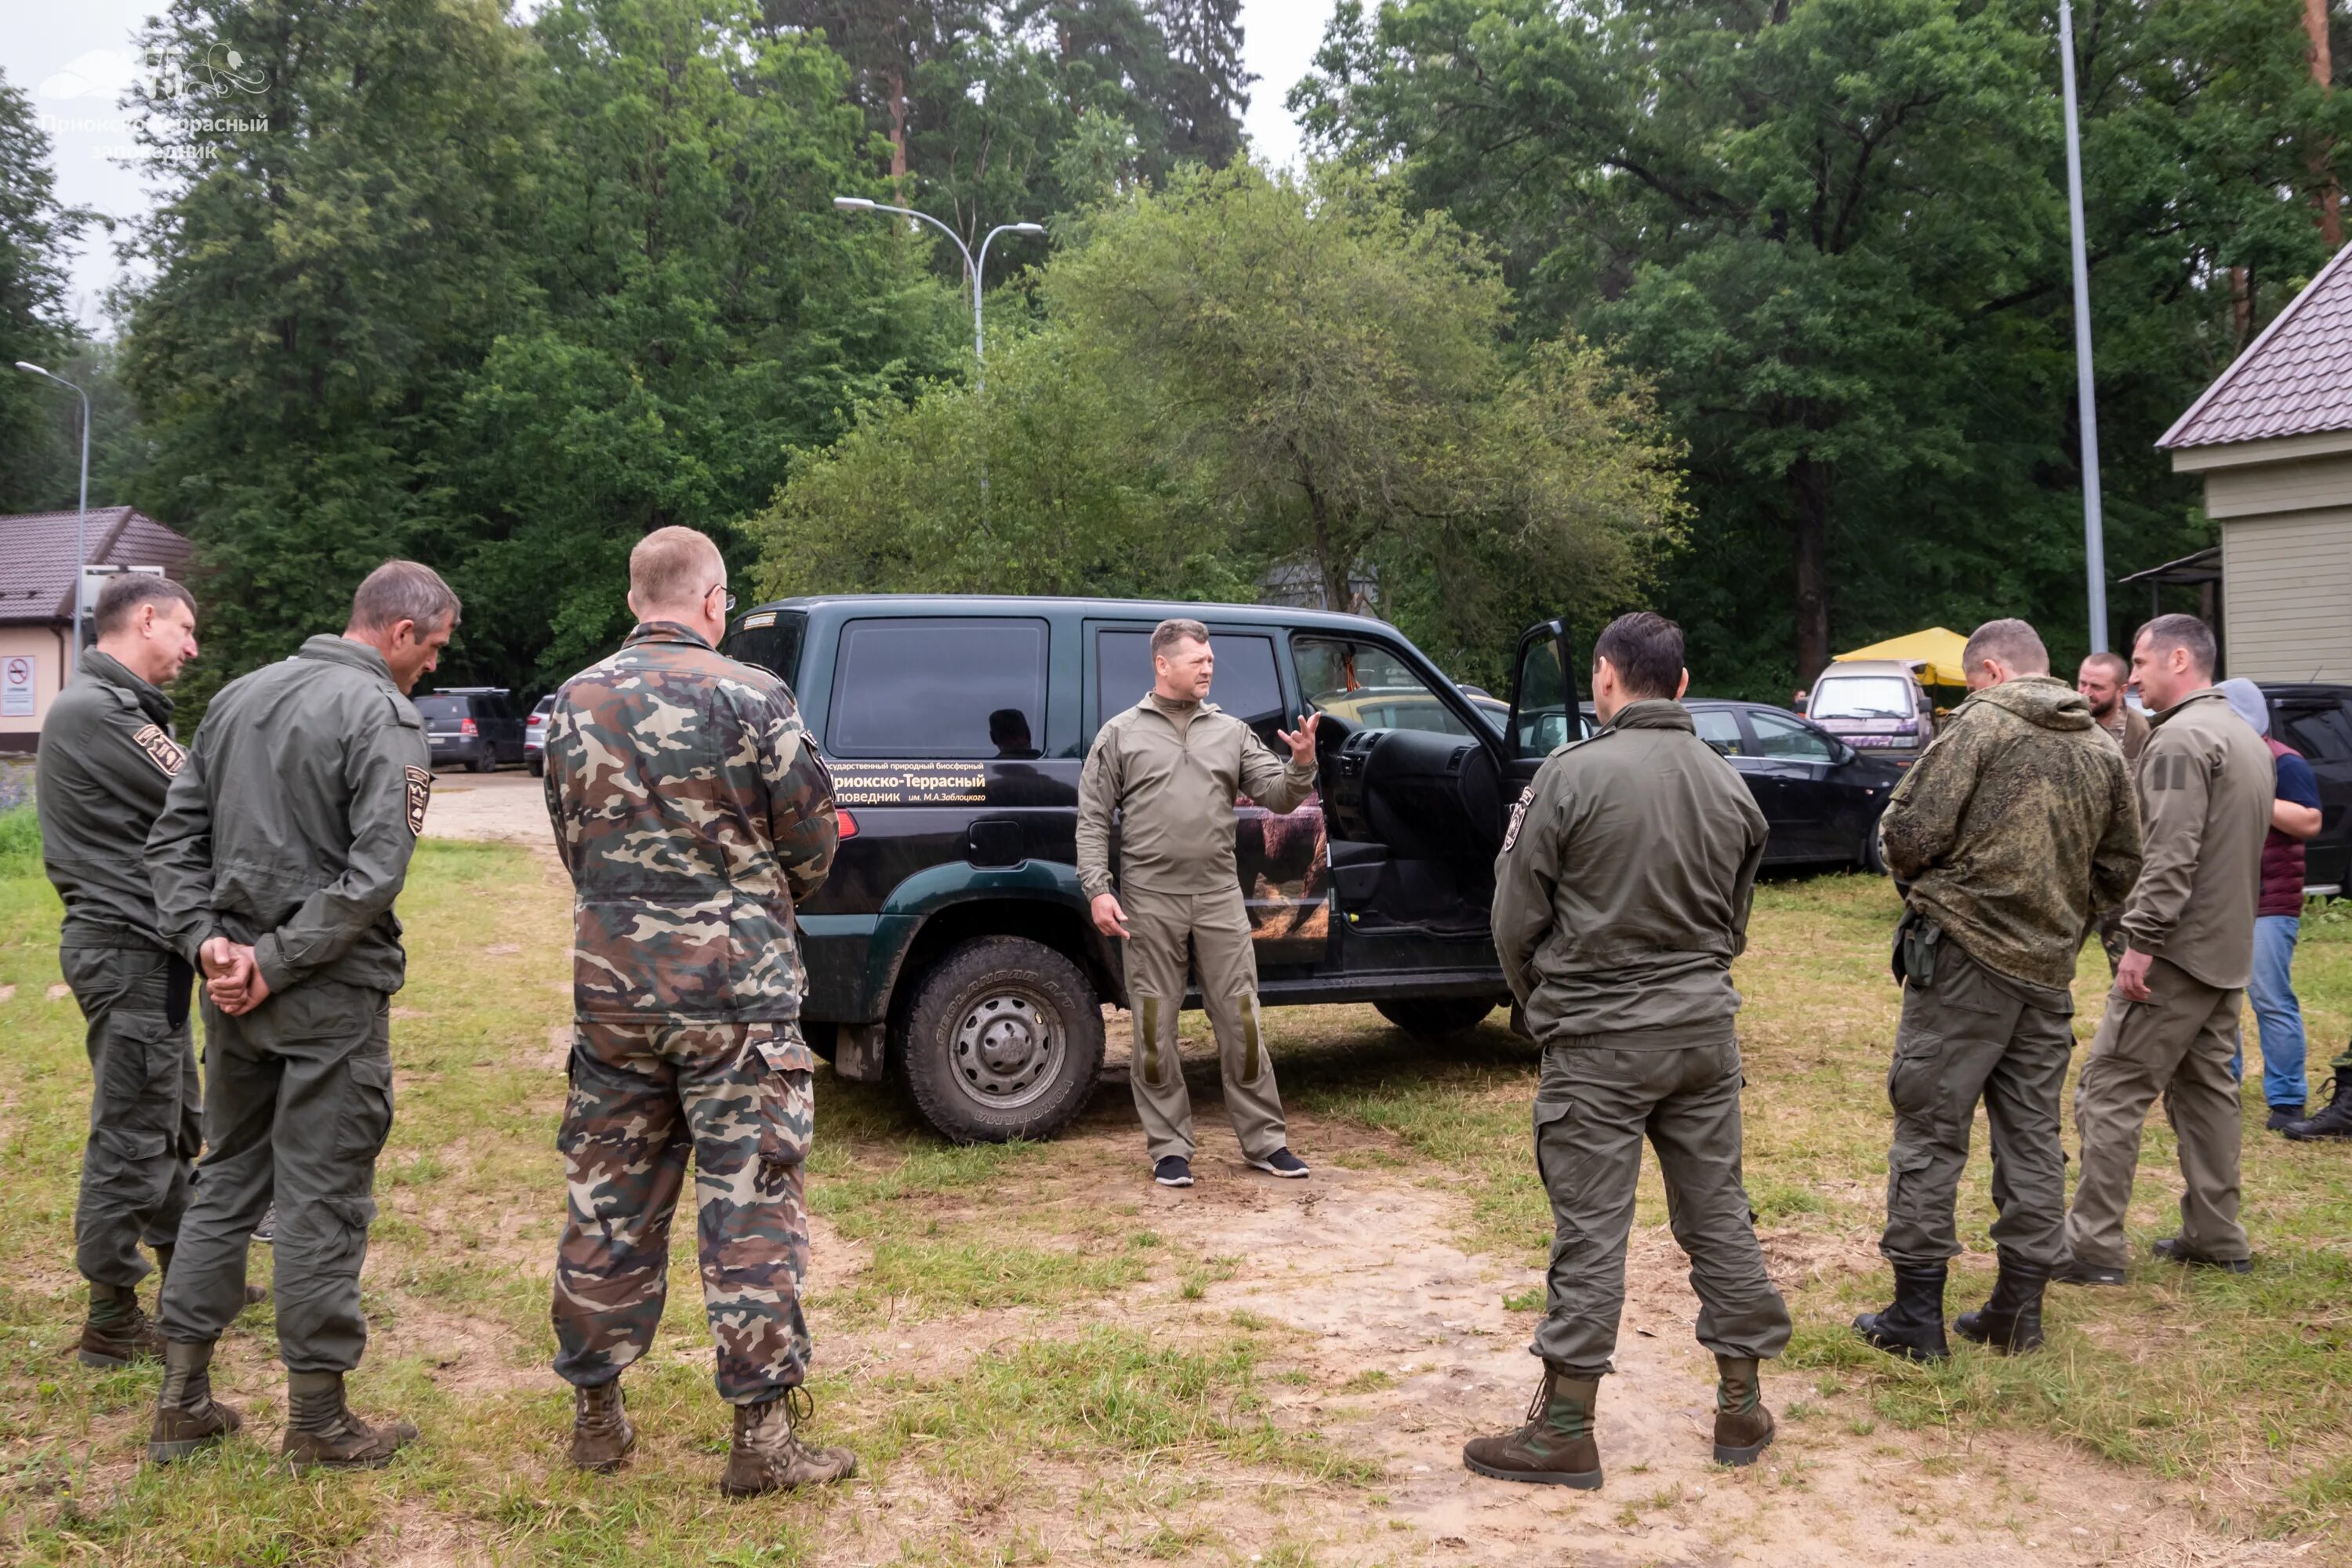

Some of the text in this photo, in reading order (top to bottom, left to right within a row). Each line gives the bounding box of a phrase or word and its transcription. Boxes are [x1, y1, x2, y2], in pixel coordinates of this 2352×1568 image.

[936, 762, 984, 771] биосферный
[834, 793, 901, 804] поведник
[924, 793, 986, 803] М.А.Заблоцкого
[936, 969, 1076, 1045] GEOLANDAR A/T
[974, 1079, 1074, 1126] YOKOHAMA
